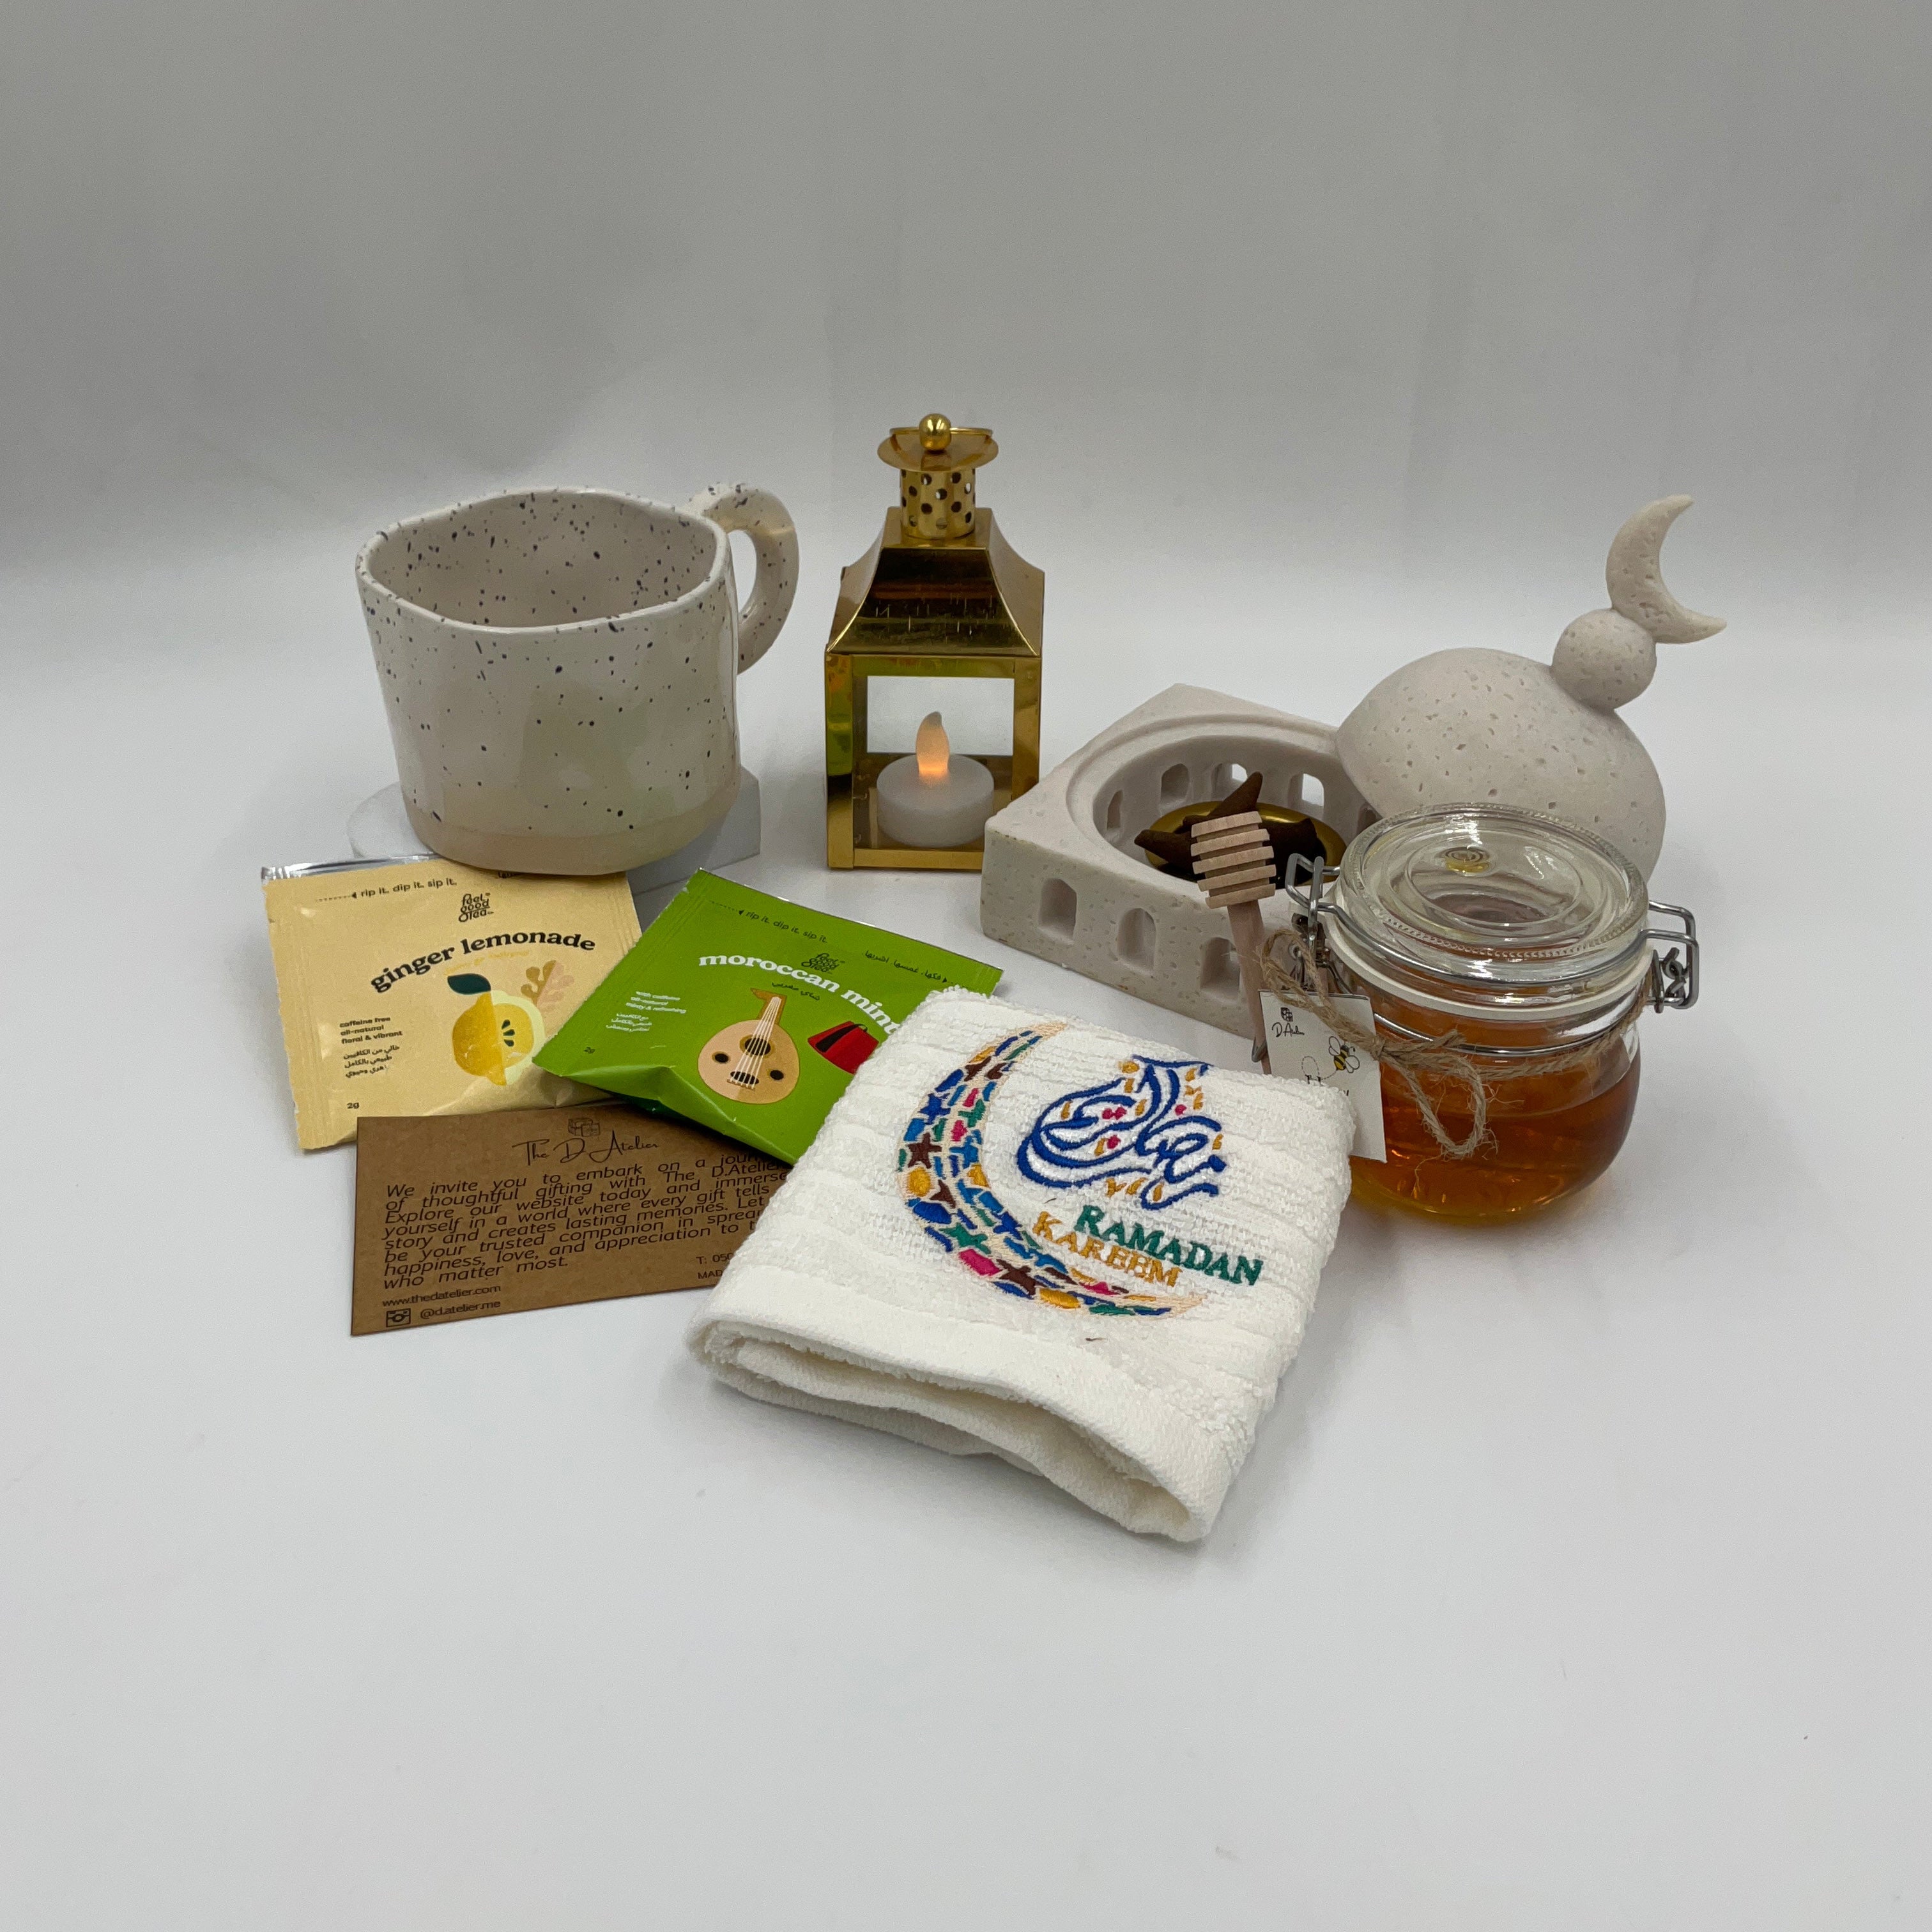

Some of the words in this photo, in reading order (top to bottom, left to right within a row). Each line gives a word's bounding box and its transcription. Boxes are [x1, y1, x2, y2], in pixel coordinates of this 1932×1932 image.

[360, 888, 376, 898] rip
[392, 884, 411, 893] dip
[427, 878, 443, 889] sip
[745, 911, 760, 920] rip
[773, 921, 789, 930] dip
[802, 931, 817, 940] sip
[371, 947, 456, 993] ginger
[459, 931, 595, 954] lemonade
[698, 954, 841, 993] moroccan
[840, 989, 901, 1035] mint
[339, 1018, 372, 1028] caffeine
[341, 1024, 385, 1036] all-natural
[341, 1036, 363, 1045] floral
[373, 1031, 403, 1039] vibrant
[346, 1101, 360, 1110] 2g
[512, 1138, 550, 1166] The
[589, 1129, 659, 1163] Atelier
[386, 1197, 408, 1213] of
[422, 1187, 519, 1208] thoughtful
[535, 1183, 593, 1200] gifting
[610, 1176, 646, 1190] with
[663, 1170, 695, 1183] The
[387, 1184, 415, 1197] We
[430, 1180, 478, 1195] invite
[492, 1177, 527, 1193] you
[542, 1173, 561, 1184] to
[576, 1163, 643, 1181] embark
[657, 1162, 680, 1172] on
[695, 1158, 706, 1169] a
[381, 1216, 463, 1240] yourself
[469, 1216, 486, 1229] in
[496, 1215, 507, 1225] a
[518, 1206, 569, 1223] world
[578, 1199, 631, 1216] where
[640, 1194, 687, 1209] every
[696, 1190, 726, 1204] gift
[735, 1183, 770, 1198] tells
[385, 1208, 454, 1226] Explore
[470, 1204, 503, 1216] our
[516, 1194, 584, 1211] website
[600, 1186, 652, 1202] today
[666, 1179, 700, 1194] and
[716, 1172, 787, 1189] immerse
[385, 1236, 433, 1251] story
[443, 1228, 479, 1244] and
[488, 1222, 556, 1239] creates
[566, 1213, 627, 1230] lasting
[637, 1202, 728, 1220] memories.
[737, 1196, 765, 1209] Let
[385, 1250, 408, 1263] be
[419, 1245, 466, 1262] your
[480, 1233, 546, 1253] trusted
[559, 1220, 664, 1242] companion
[678, 1215, 693, 1228] in
[384, 1255, 486, 1276] happiness,
[496, 1250, 539, 1264] love,
[549, 1241, 585, 1256] and
[595, 1226, 711, 1252] appreciation
[720, 1222, 739, 1234] to
[696, 1256, 707, 1264] T:
[1032, 1211, 1183, 1287] KAREEM
[1073, 1204, 1264, 1286] RAMADAN
[384, 1275, 424, 1290] who
[438, 1264, 505, 1283] matter
[516, 1256, 569, 1273] most.
[698, 1269, 723, 1279] MAD
[382, 1285, 501, 1307] www.thedatelier.com
